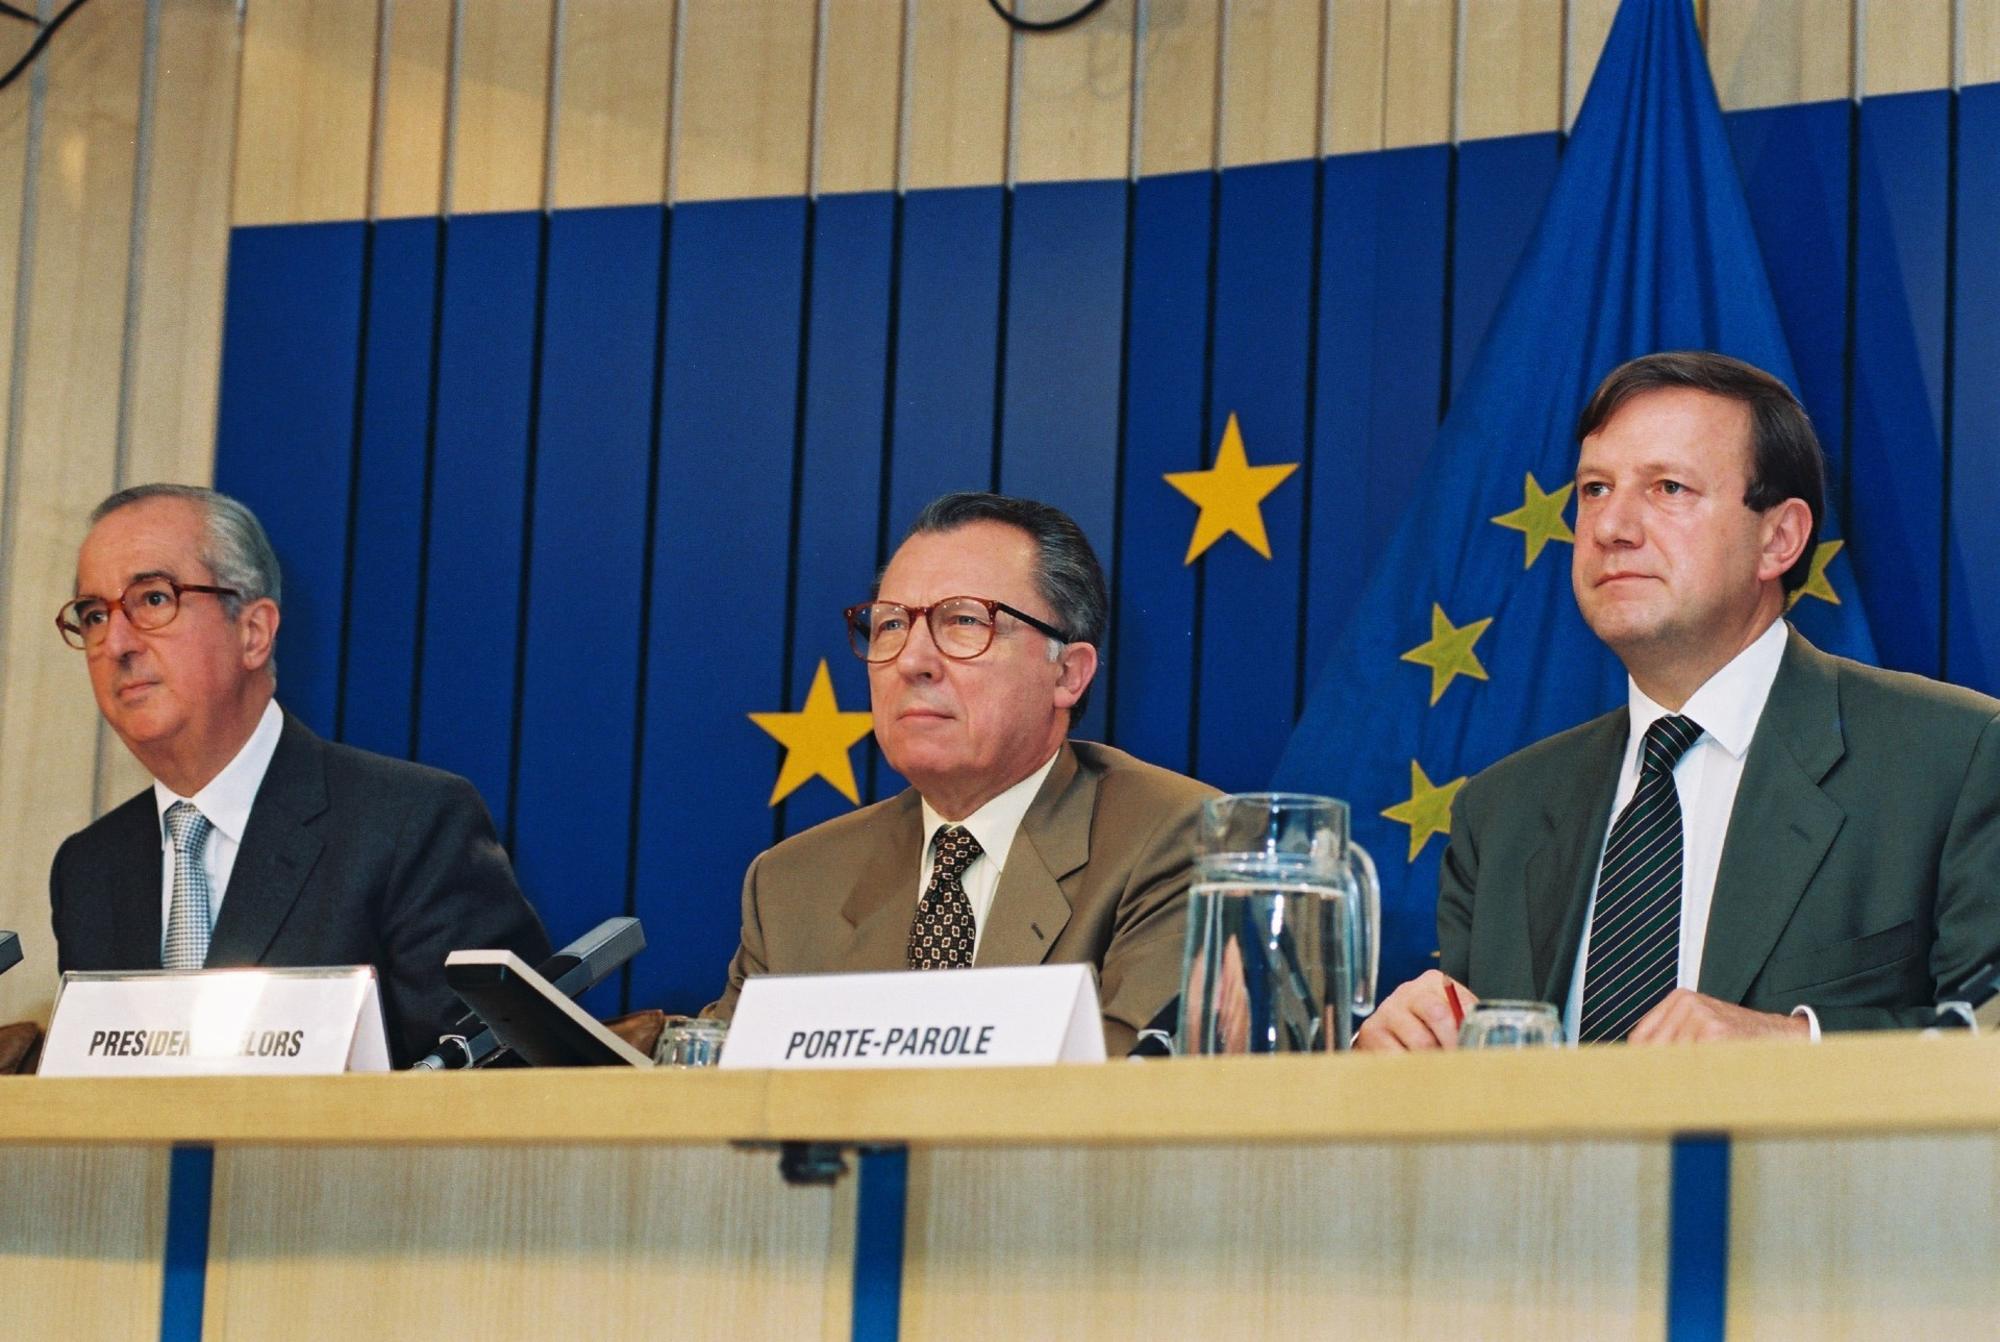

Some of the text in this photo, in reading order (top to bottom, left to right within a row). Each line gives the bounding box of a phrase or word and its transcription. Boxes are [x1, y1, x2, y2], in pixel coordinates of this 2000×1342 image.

[88, 1029, 304, 1057] PRESIDEN LORS
[785, 1026, 994, 1060] PORTE-PAROLE
